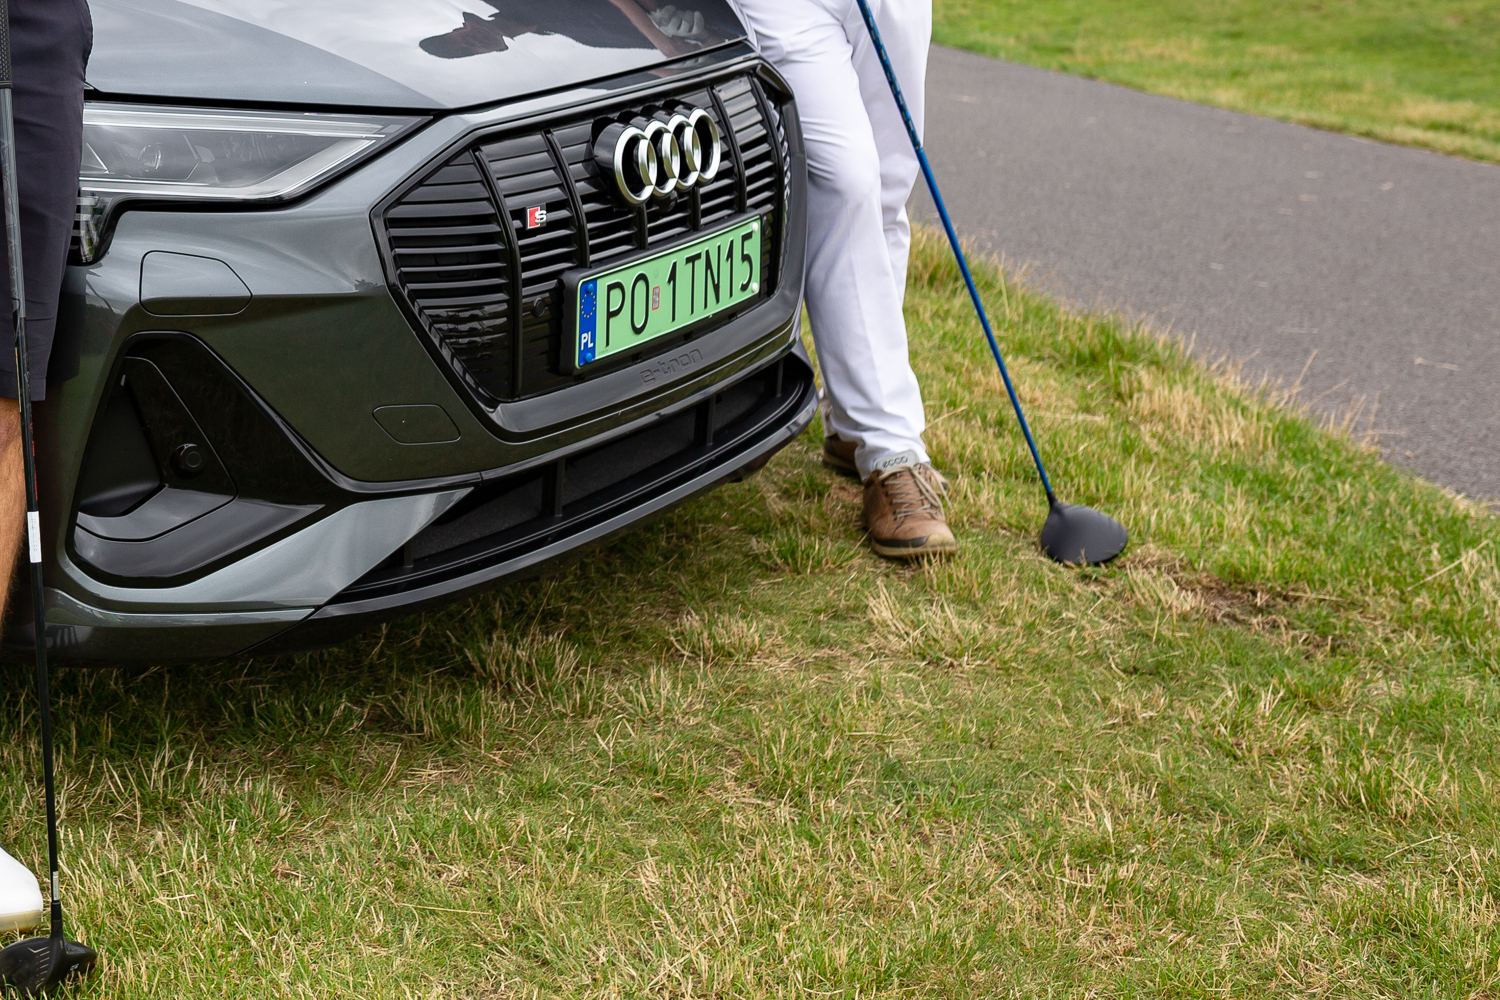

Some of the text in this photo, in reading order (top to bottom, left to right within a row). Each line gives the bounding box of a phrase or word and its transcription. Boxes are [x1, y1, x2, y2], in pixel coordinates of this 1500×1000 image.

[605, 230, 754, 348] PO 1TN15
[581, 331, 594, 351] PL
[639, 348, 704, 383] e-tron
[882, 456, 908, 468] ecco
